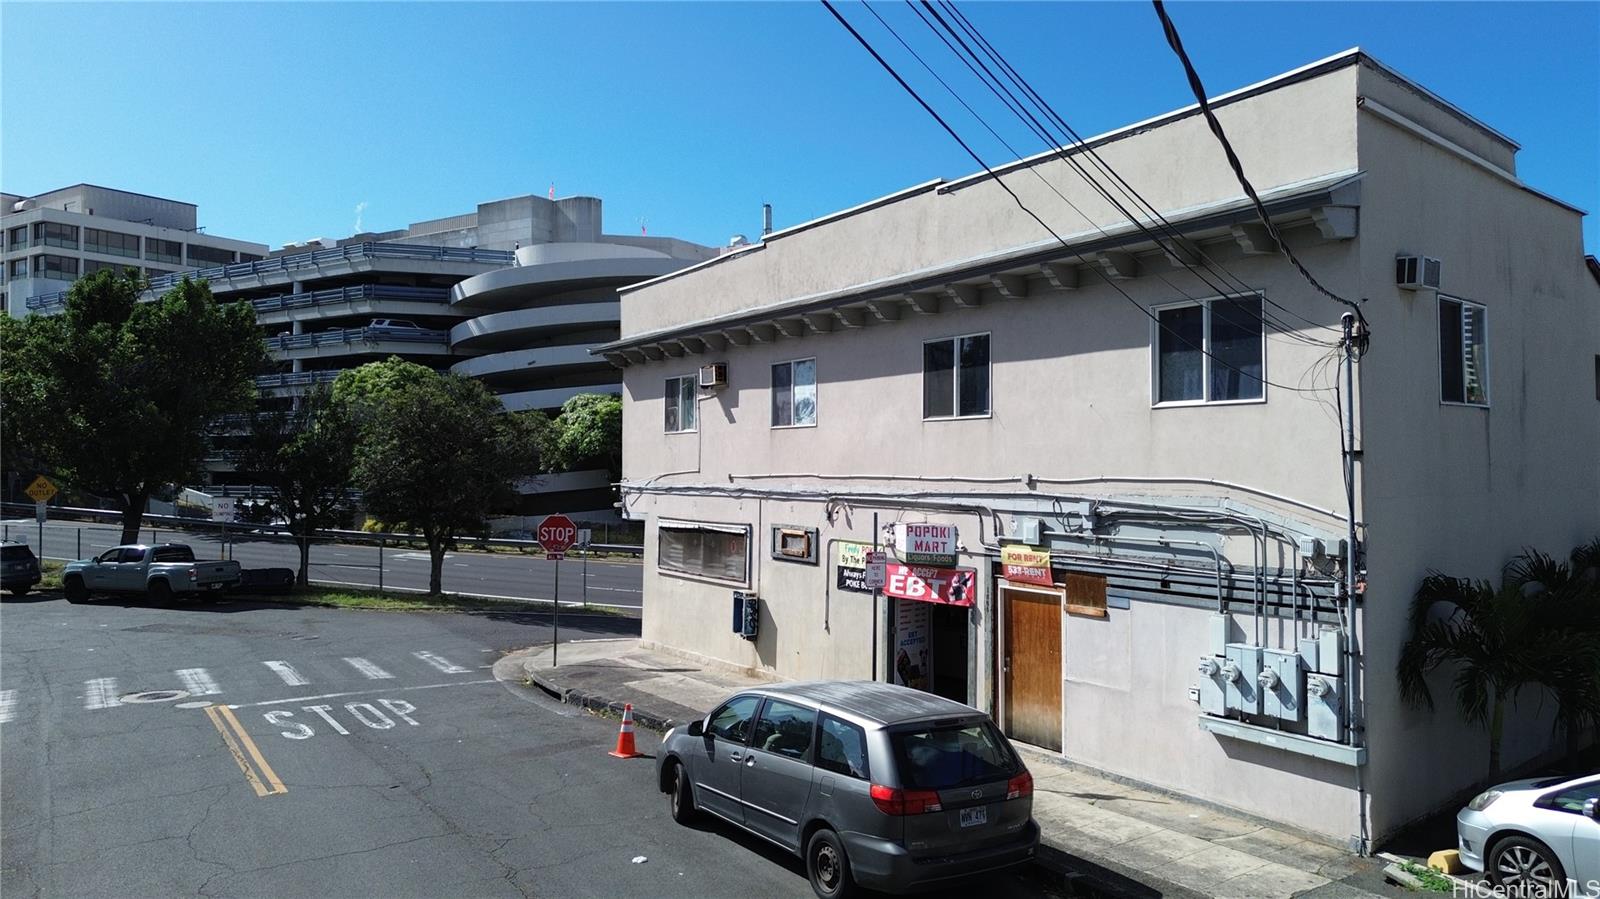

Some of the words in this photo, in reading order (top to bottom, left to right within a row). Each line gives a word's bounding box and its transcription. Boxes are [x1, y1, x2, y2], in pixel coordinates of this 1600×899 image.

[28, 489, 56, 497] OUTLET
[540, 527, 574, 541] STOP
[907, 526, 951, 539] POPOKI
[914, 540, 947, 553] MART
[842, 555, 849, 565] By
[850, 556, 860, 564] The
[1007, 553, 1022, 561] FOR
[843, 569, 863, 579] Always
[913, 567, 938, 578] ACCEPT
[846, 579, 861, 589] POKE
[889, 574, 947, 600] EBT
[263, 698, 420, 739] STOP
